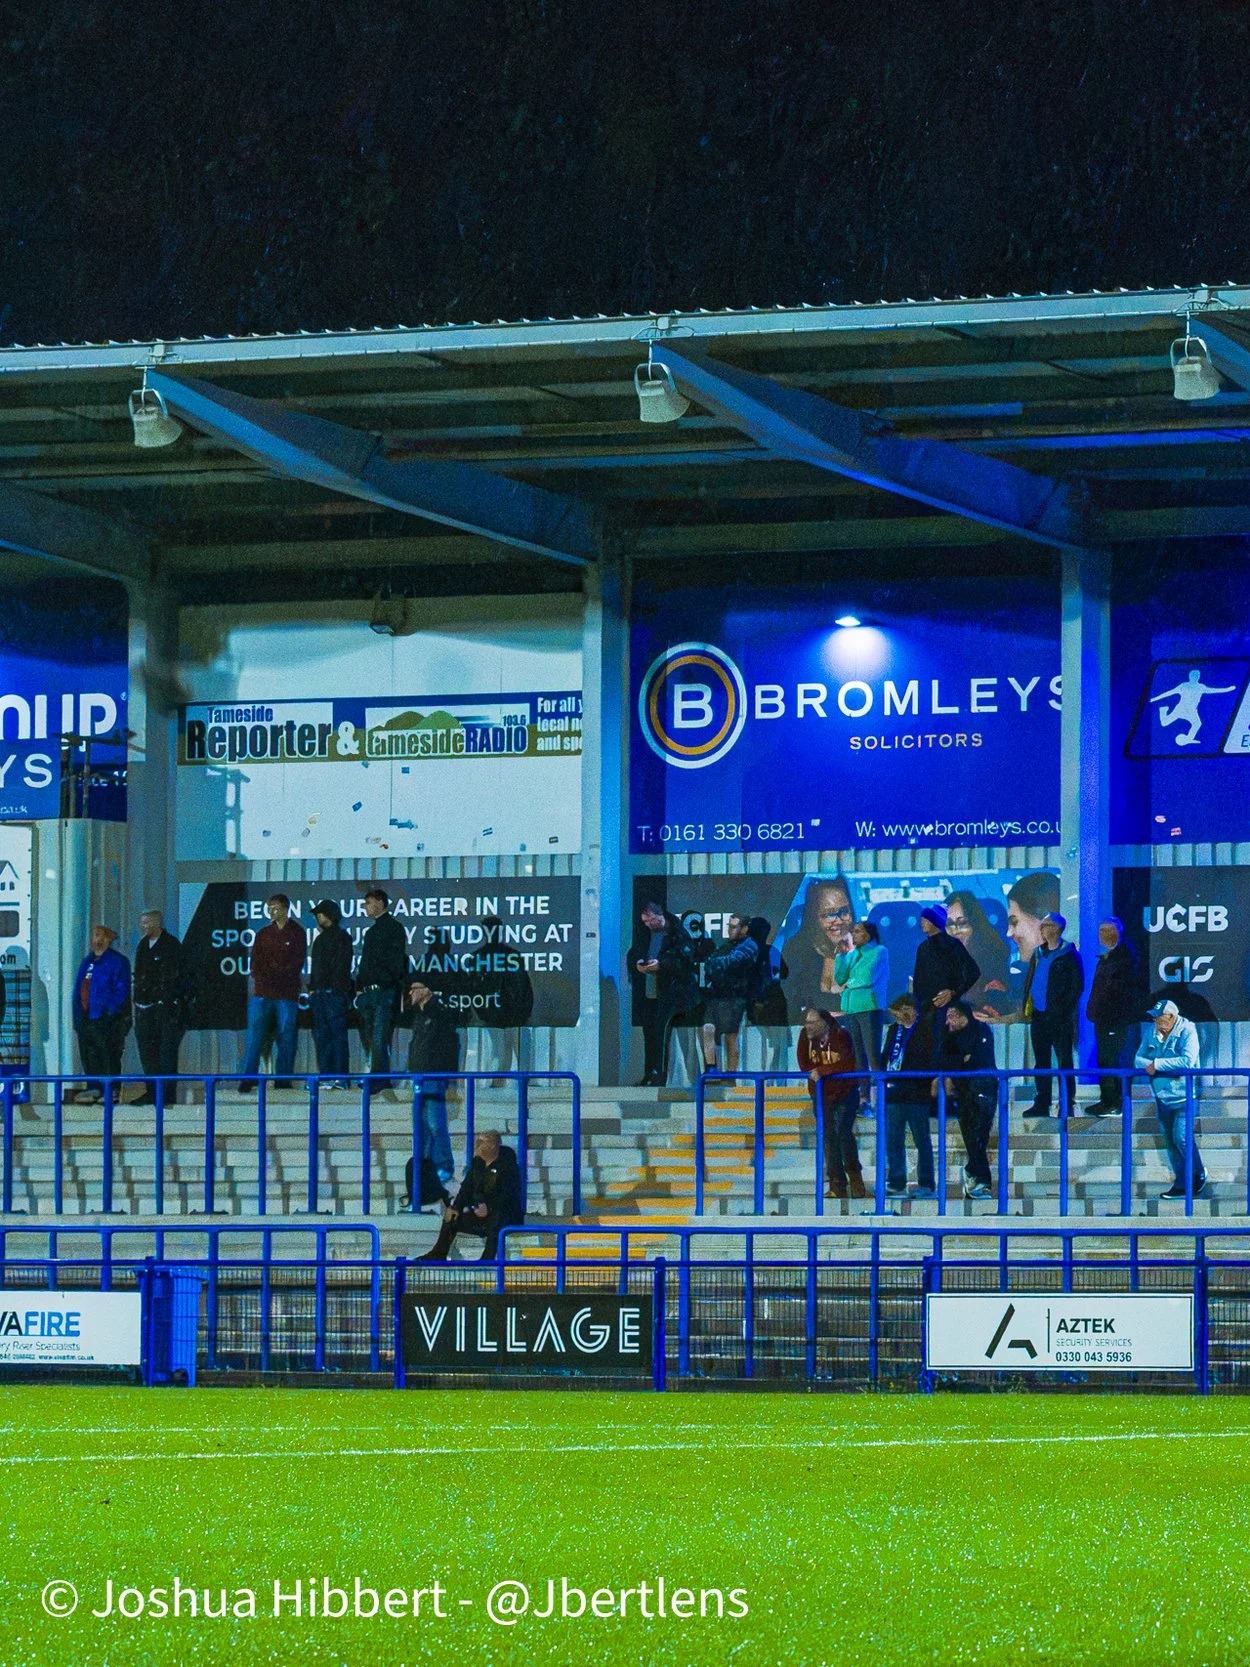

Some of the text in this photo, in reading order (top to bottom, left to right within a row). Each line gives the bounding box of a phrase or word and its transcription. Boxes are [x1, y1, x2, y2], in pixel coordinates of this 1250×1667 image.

[537, 697, 557, 713] For
[559, 696, 576, 713] all
[673, 682, 714, 729] B
[207, 705, 274, 724] Tameside
[502, 714, 527, 727] 103.6
[537, 716, 569, 732] local
[186, 719, 360, 763] Reporter &
[537, 734, 561, 751] and
[849, 732, 984, 751] SOLICITORS
[636, 822, 805, 842] T: 0161 330 6821
[855, 821, 876, 838] W:
[387, 896, 468, 917] AREER
[475, 896, 498, 916] IN
[506, 895, 550, 916] THE
[1142, 903, 1229, 933] UCFB
[424, 923, 537, 945] STUDYING
[544, 923, 573, 943] AT
[408, 952, 563, 974] MANCHESTER
[1158, 955, 1215, 983] GIS
[414, 1305, 640, 1355] VILLAGE
[1056, 1318, 1116, 1334] AZTEK
[35, 1341, 81, 1352] Specialists
[1056, 1338, 1133, 1347] SECURITY SERVICES
[1056, 1352, 1132, 1363] 0330 043 5936
